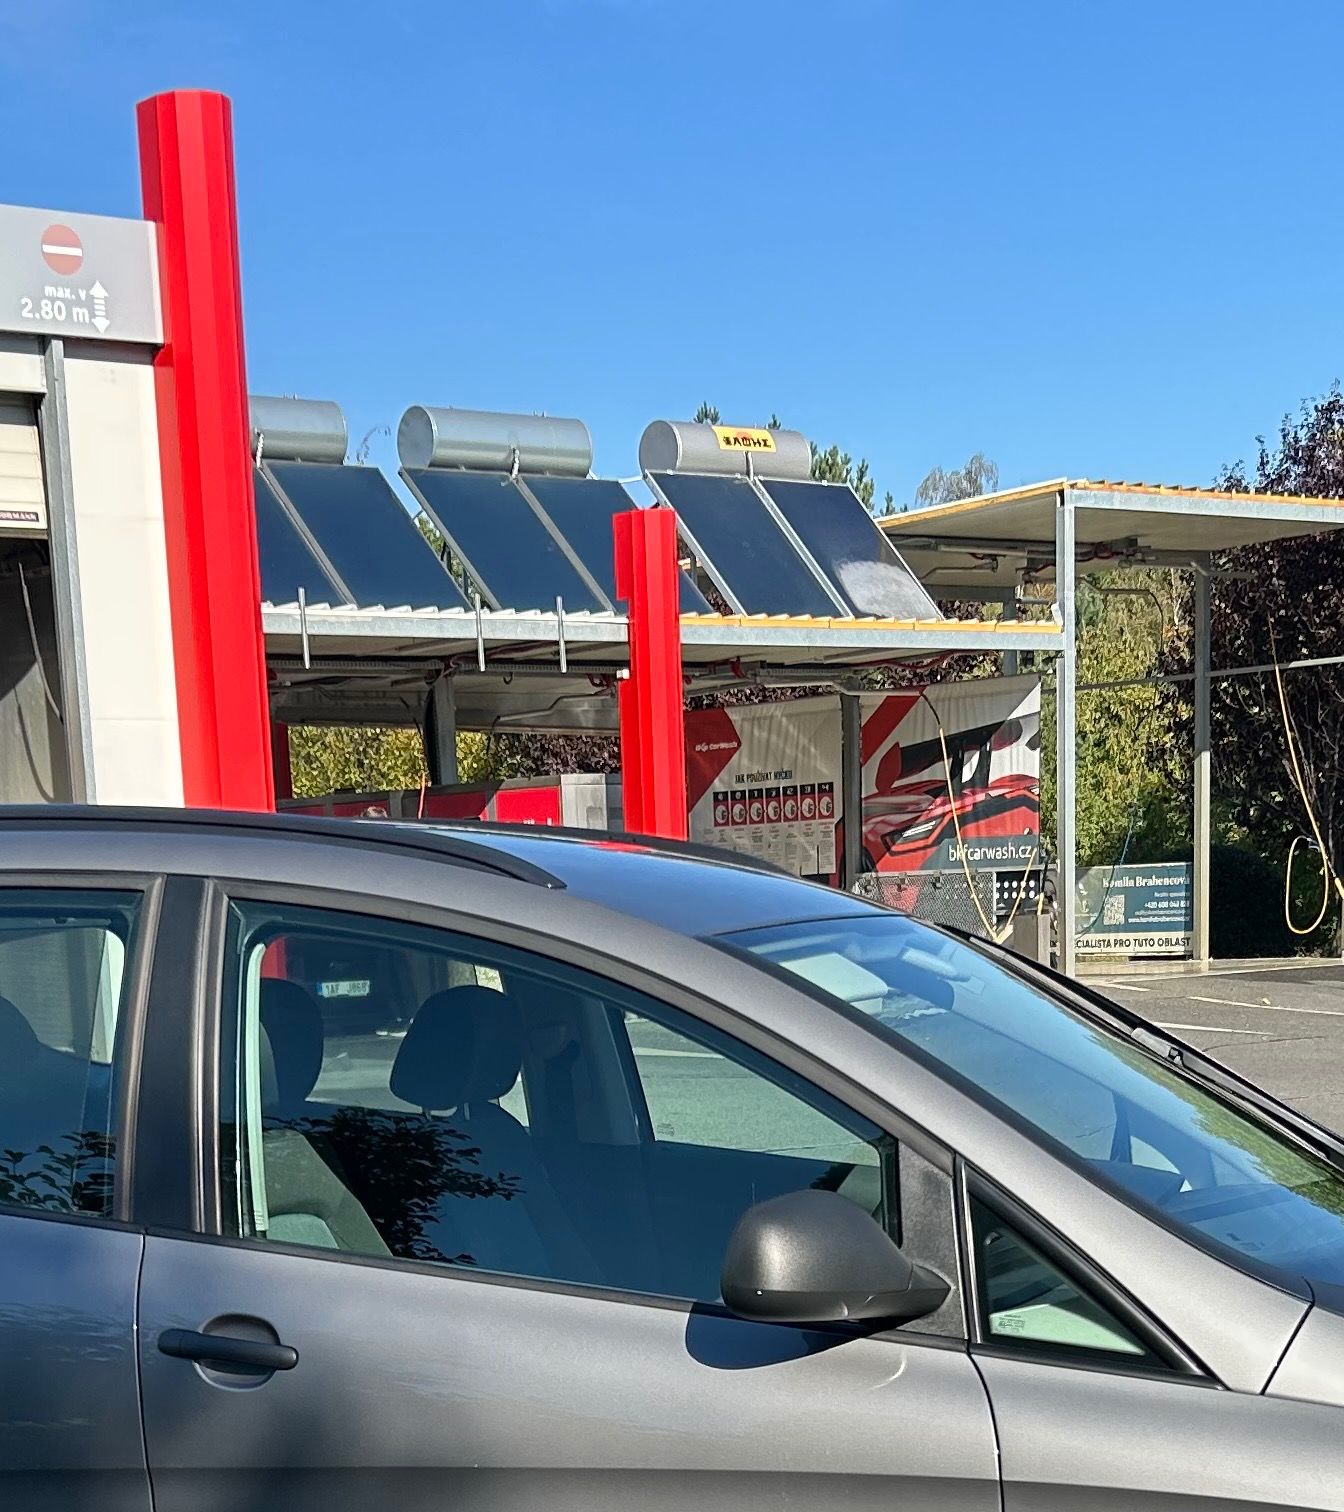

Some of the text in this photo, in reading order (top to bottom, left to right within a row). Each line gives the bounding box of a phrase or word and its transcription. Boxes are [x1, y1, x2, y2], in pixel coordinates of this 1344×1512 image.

[44, 285, 76, 299] max.
[21, 297, 90, 324] 2.80 m
[1075, 937, 1191, 949] CIALISTA PRO TUTO OBLAST
